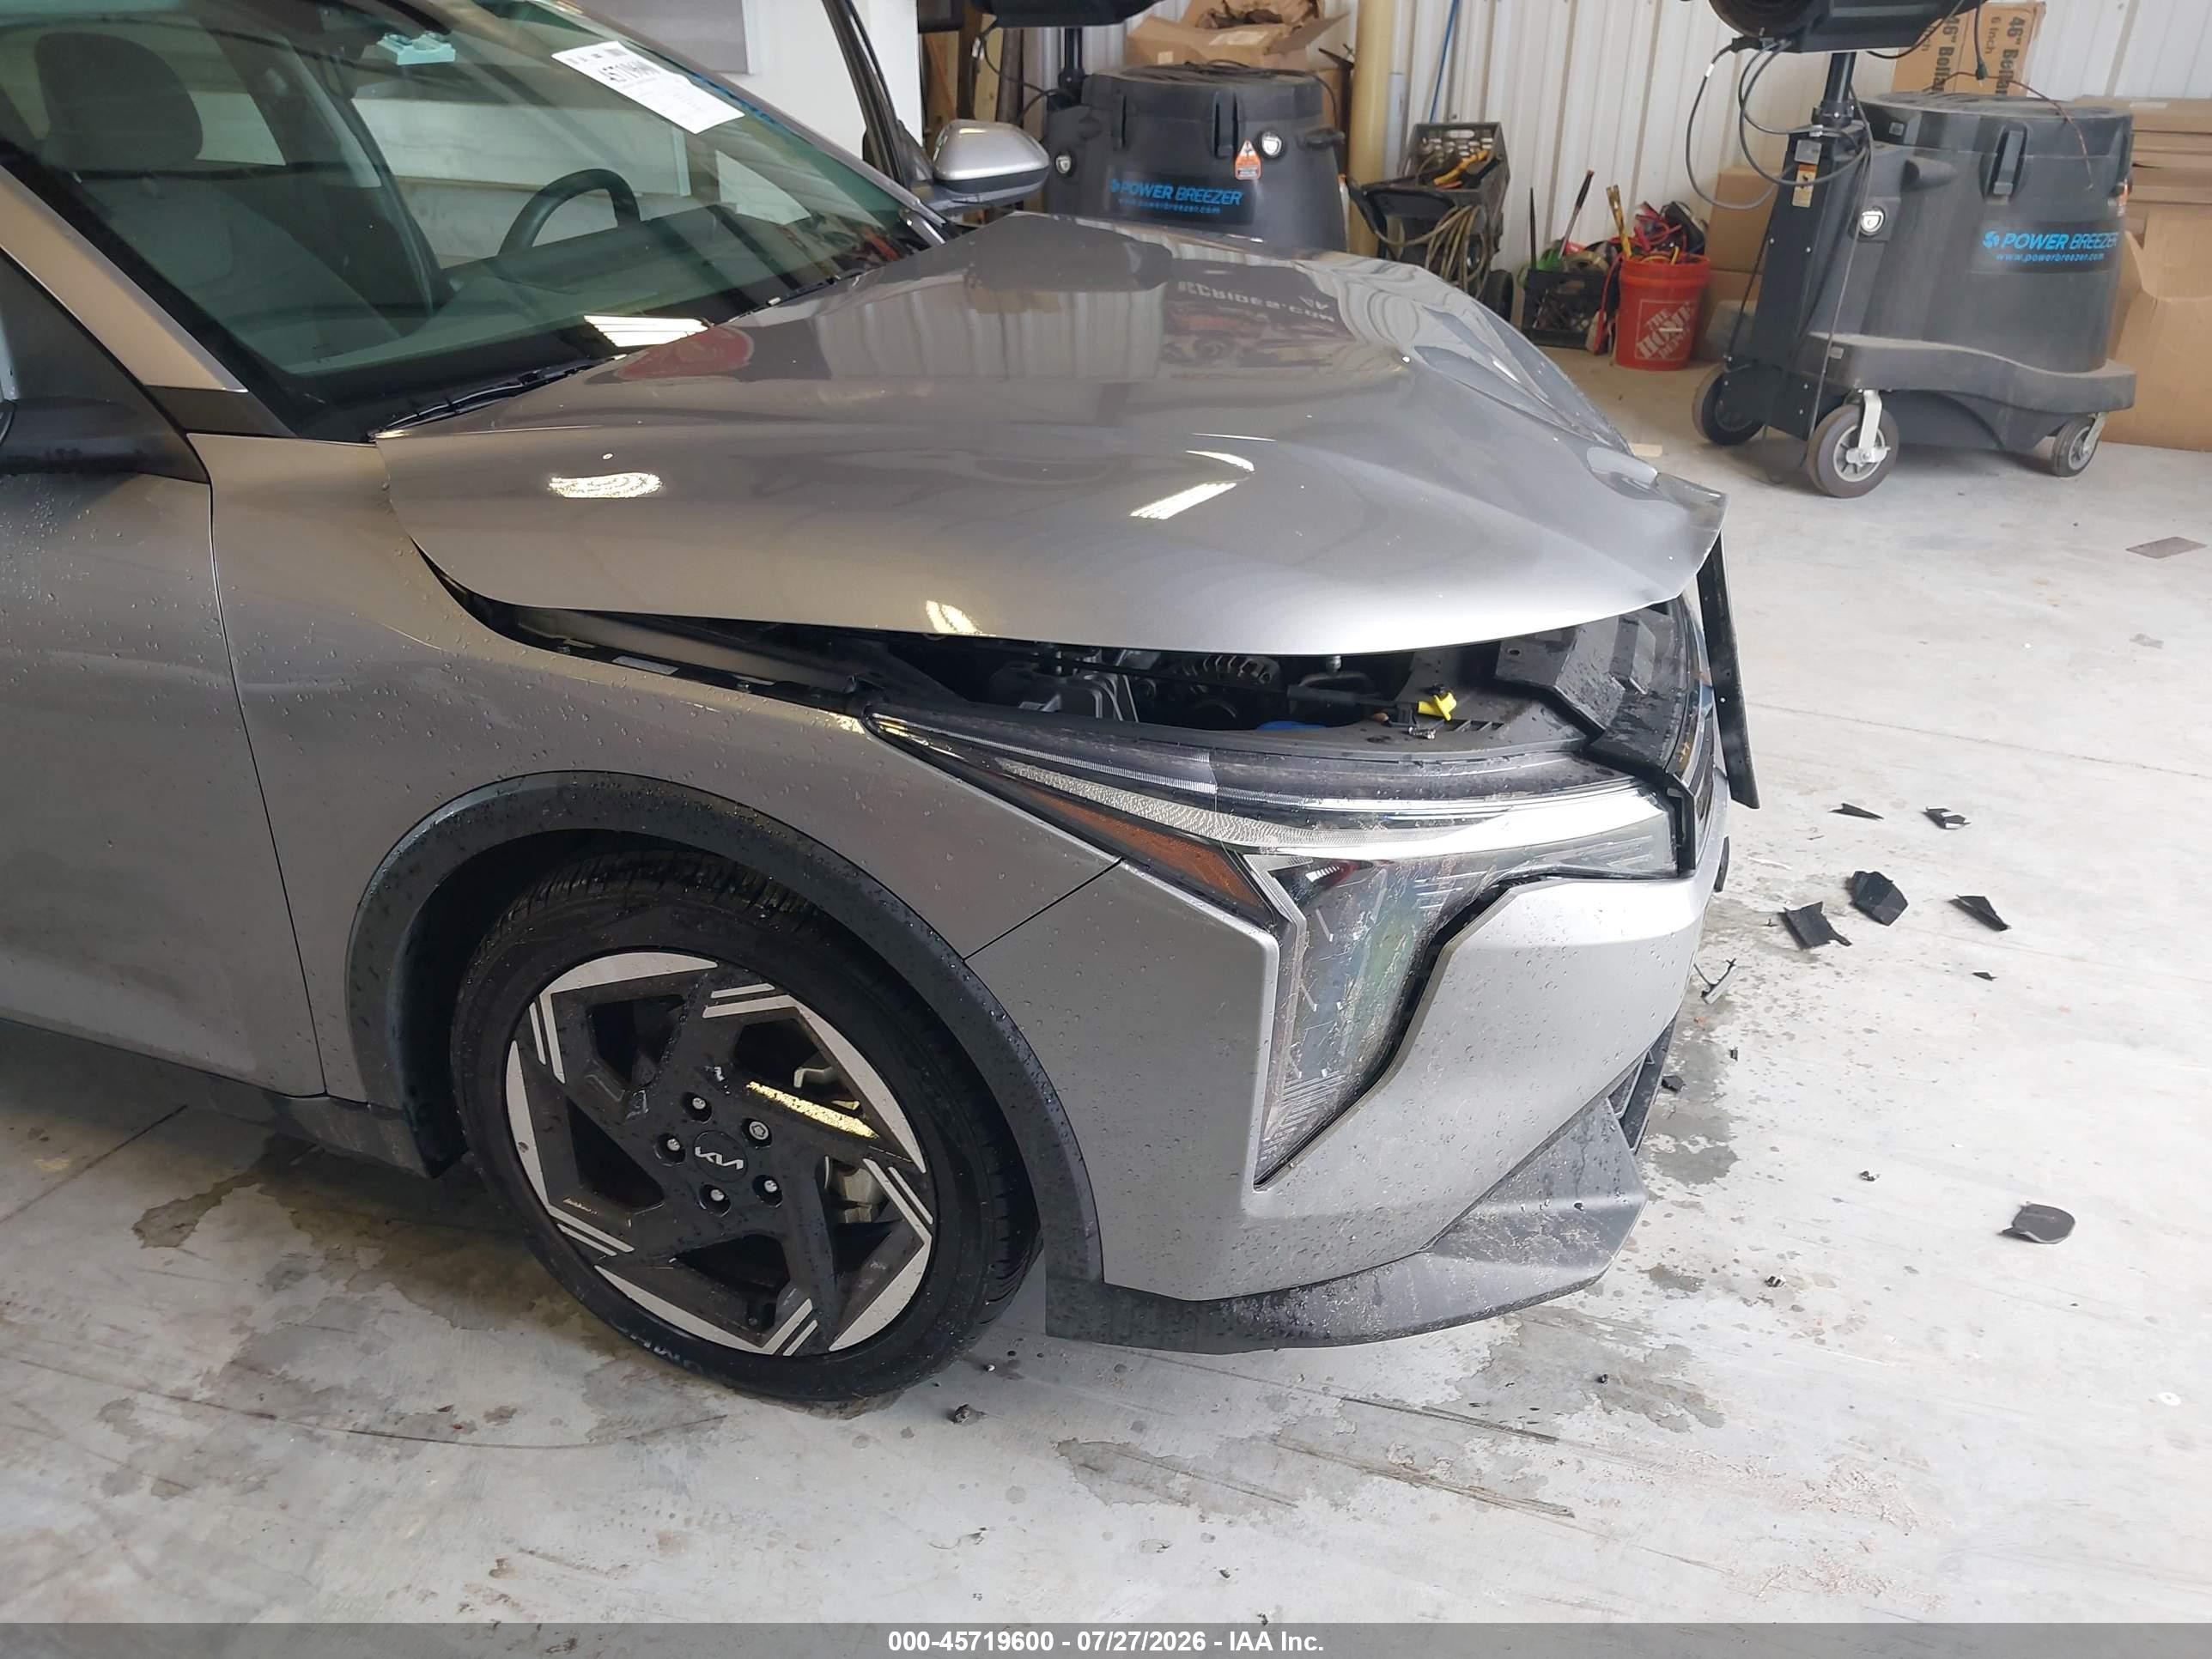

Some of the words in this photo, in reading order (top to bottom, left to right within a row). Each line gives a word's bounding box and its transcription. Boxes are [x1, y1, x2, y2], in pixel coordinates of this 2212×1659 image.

[1985, 27, 1999, 54] Inch
[1120, 181, 1174, 200] POWER
[1175, 185, 1243, 205] BREEZER
[2002, 232, 2069, 250] POWER
[2069, 232, 2118, 250] BREEZER
[1996, 252, 2106, 262] www.powerbreezer.com
[1636, 303, 1692, 359] HOME
[1644, 308, 1671, 331] THE
